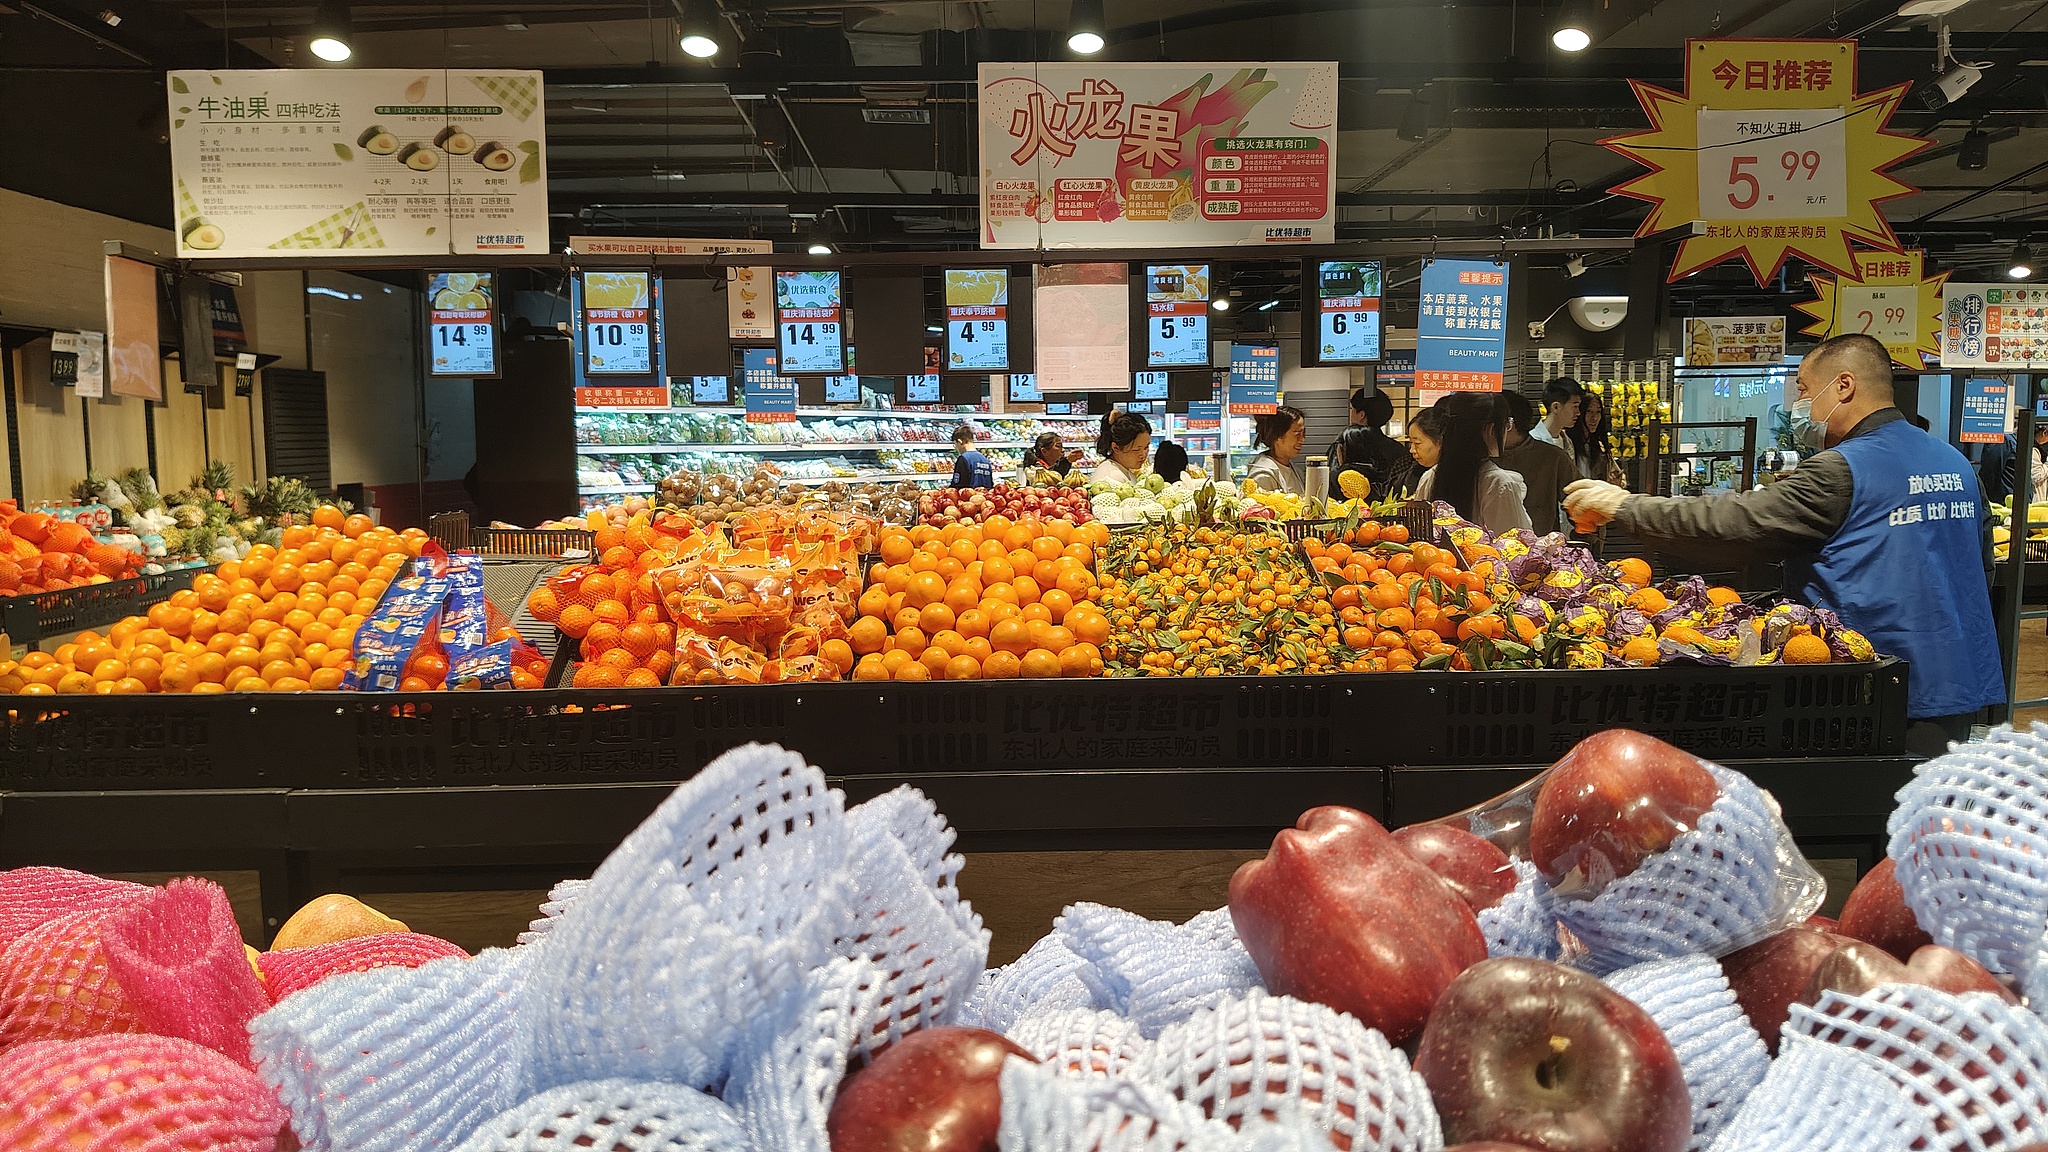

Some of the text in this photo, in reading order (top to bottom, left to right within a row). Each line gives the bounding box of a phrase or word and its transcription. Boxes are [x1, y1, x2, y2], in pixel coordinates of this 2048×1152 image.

[1712, 58, 1834, 91] 今日推荐
[198, 96, 341, 119] 牛油果 四种吃法
[1009, 78, 1182, 170] 火龙果
[1736, 121, 1802, 135] 不知火丑柑
[1211, 158, 1235, 170] 颜色
[995, 180, 1036, 190] 白心火龙果
[1062, 180, 1103, 190] 红心火龙果
[1134, 180, 1175, 190] 黄皮火龙果
[1210, 180, 1236, 191] 重量
[1207, 202, 1239, 213] 成熟度
[1265, 227, 1312, 237] 比优特超市
[1706, 225, 1827, 239] 东北人的家庭采购员
[476, 235, 525, 244] 比优特超市
[1858, 260, 1911, 279] 日推荐
[1460, 272, 1503, 285] 温馨提示
[790, 285, 827, 295] 优选鲜食
[1423, 292, 1503, 306] 本店蔬菜、水果
[1422, 304, 1502, 318] 请直接到收银台
[1444, 317, 1502, 330] 称重并结账
[1732, 323, 1767, 335] 菠萝蜜
[1947, 297, 1962, 354] 水果糖分
[1962, 296, 1982, 358] 排行榜
[1449, 349, 1499, 359] BEAUTY MART
[585, 397, 661, 405] 不必二次排队省时间!
[1908, 473, 1964, 495] 放心买好货
[1888, 500, 1975, 527] 比质 比价 比优特
[1550, 682, 1772, 726] 比优特超市
[1003, 692, 1224, 735] 比优特超市
[1002, 735, 1221, 761] 东北人的家庭采购员
[452, 749, 682, 777] 东北人的家庭采购员
